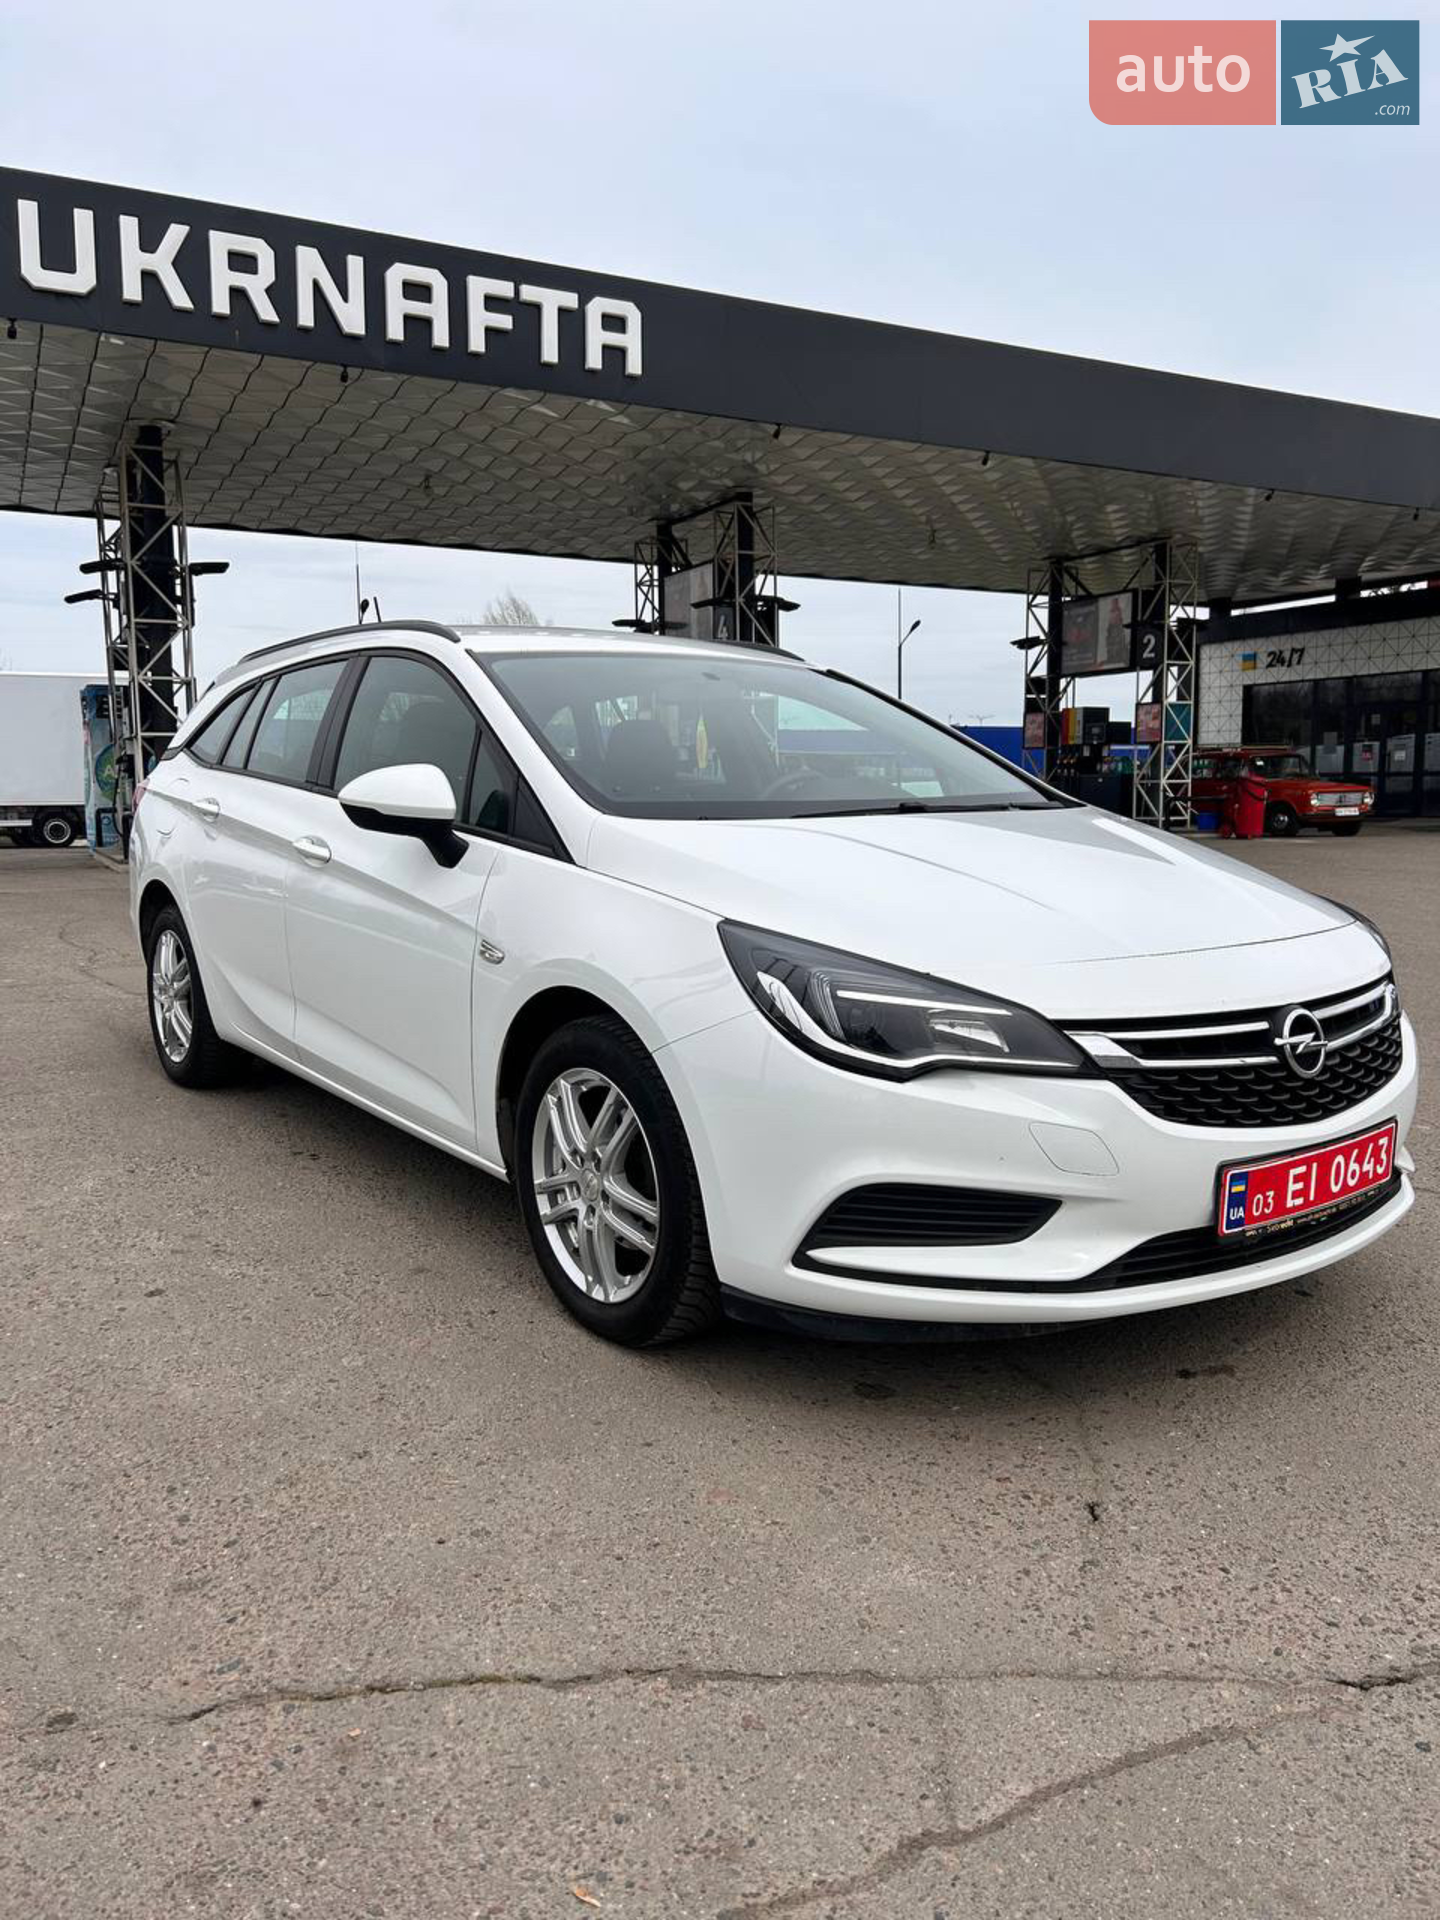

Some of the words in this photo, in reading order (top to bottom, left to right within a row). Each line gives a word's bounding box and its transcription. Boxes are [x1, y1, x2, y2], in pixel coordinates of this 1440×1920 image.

[17, 198, 643, 377] UKRNAFTA
[717, 614, 729, 641] 4
[1142, 633, 1156, 659] 2
[1265, 647, 1306, 669] 24/7
[1252, 1191, 1275, 1216] 03
[1286, 1163, 1317, 1208] EI
[1330, 1136, 1389, 1193] 0643
[1229, 1206, 1245, 1220] UA
